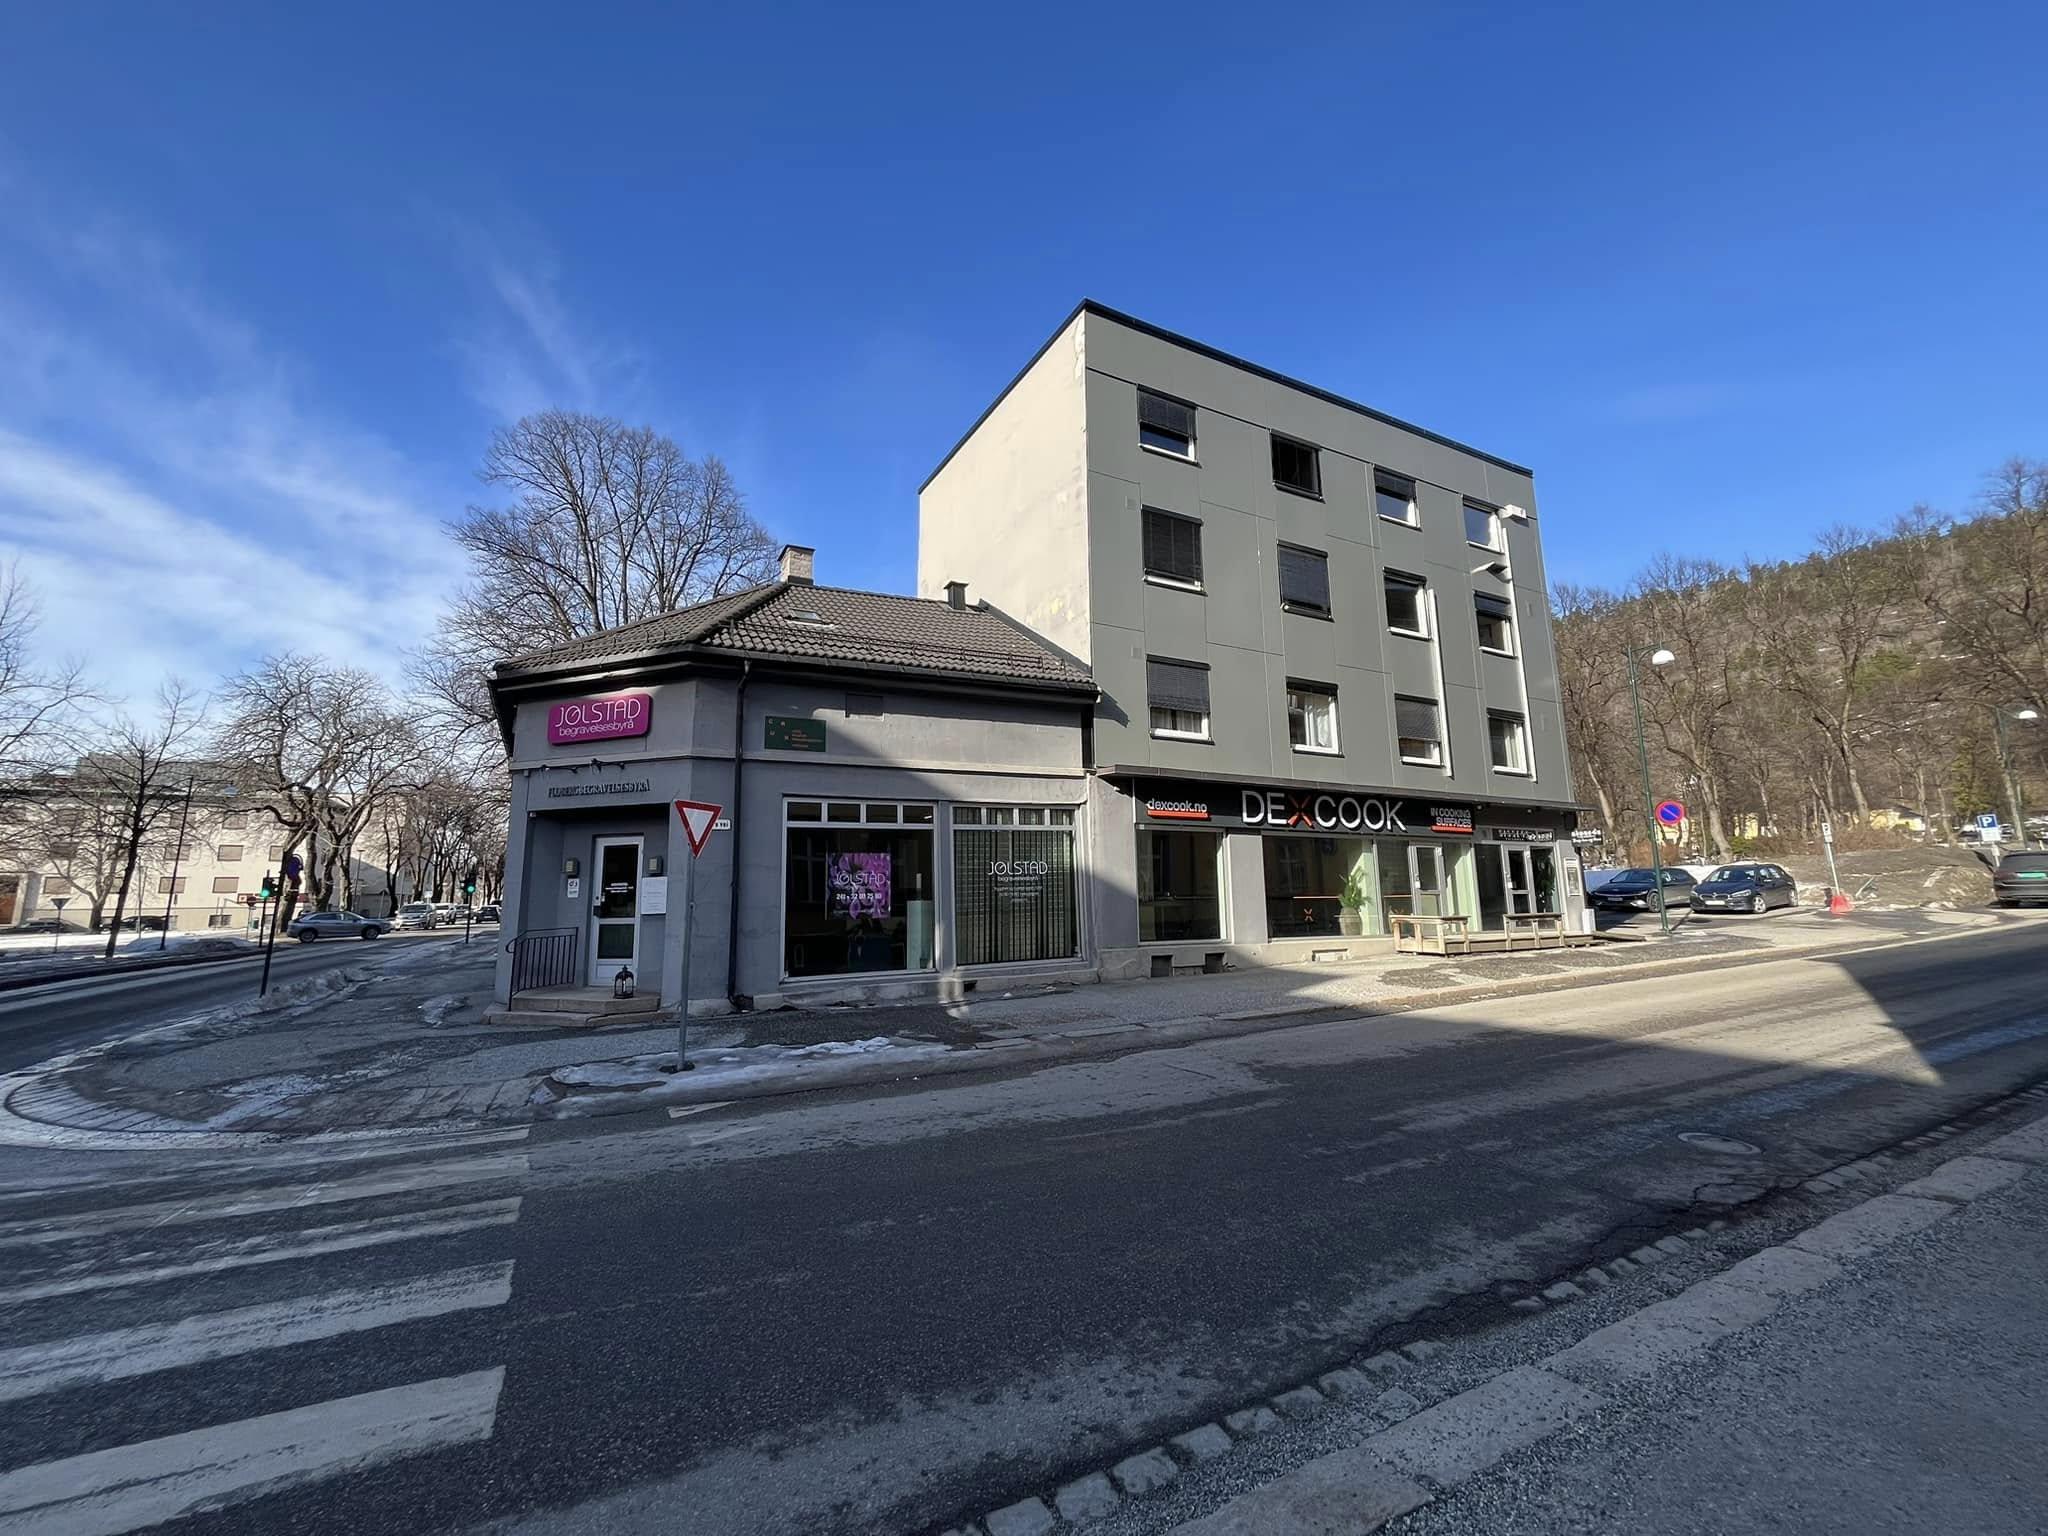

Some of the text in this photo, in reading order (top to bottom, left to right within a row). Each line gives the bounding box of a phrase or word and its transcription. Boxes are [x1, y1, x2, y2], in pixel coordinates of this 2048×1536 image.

[555, 698, 641, 728] JØLSTAD
[559, 718, 635, 738] begravelsesbyrå
[1145, 797, 1208, 813] dexcook.no
[1241, 790, 1407, 832] DEXCOOK
[1439, 808, 1471, 819] COOKING
[1436, 816, 1472, 828] SURFACES
[1981, 816, 1993, 827] P
[987, 861, 1048, 875] JØLSTAD
[835, 870, 886, 885] JØLSTAD
